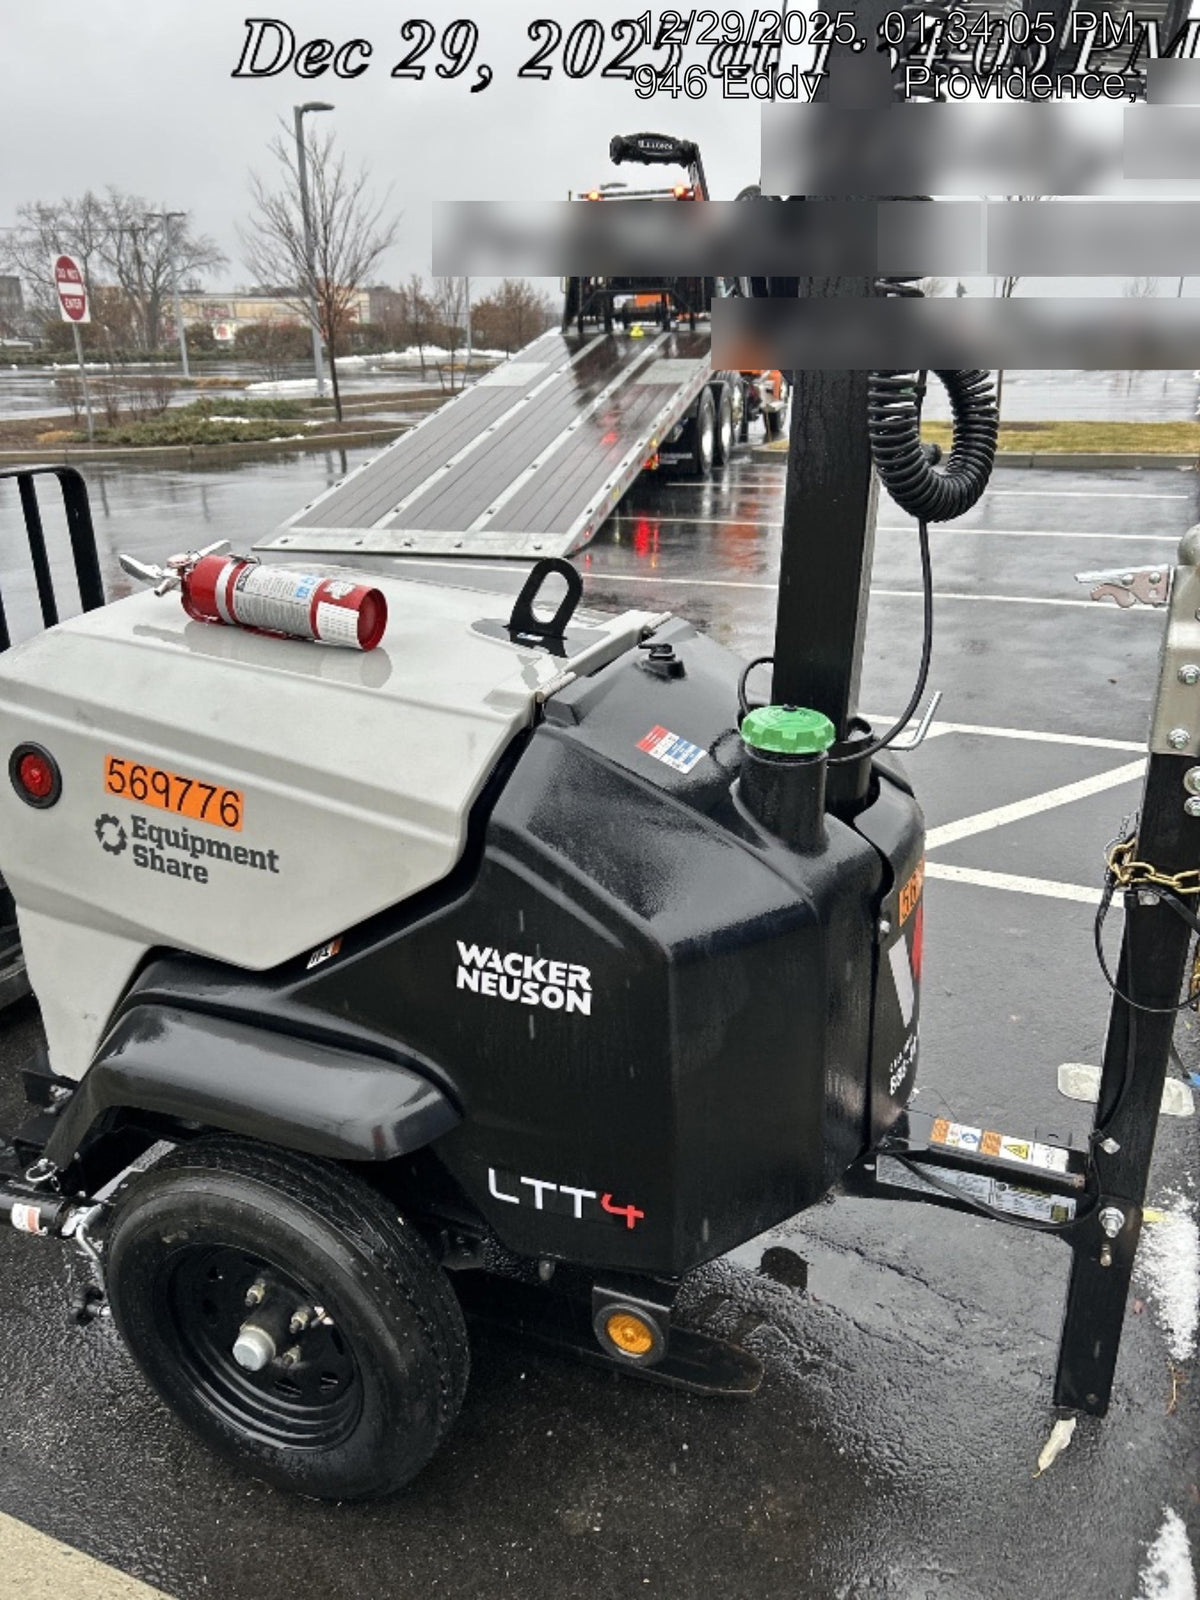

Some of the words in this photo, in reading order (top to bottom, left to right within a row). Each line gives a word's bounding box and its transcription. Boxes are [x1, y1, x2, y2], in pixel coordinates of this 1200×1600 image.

[67, 268, 79, 280] NOT
[65, 298, 82, 310] ENTER
[108, 758, 240, 828] 569776
[131, 814, 280, 873] Equipment
[132, 843, 209, 884] Share
[456, 940, 592, 991] WACKER
[456, 964, 592, 1016] NEUSON
[488, 1167, 644, 1229] LTT4
